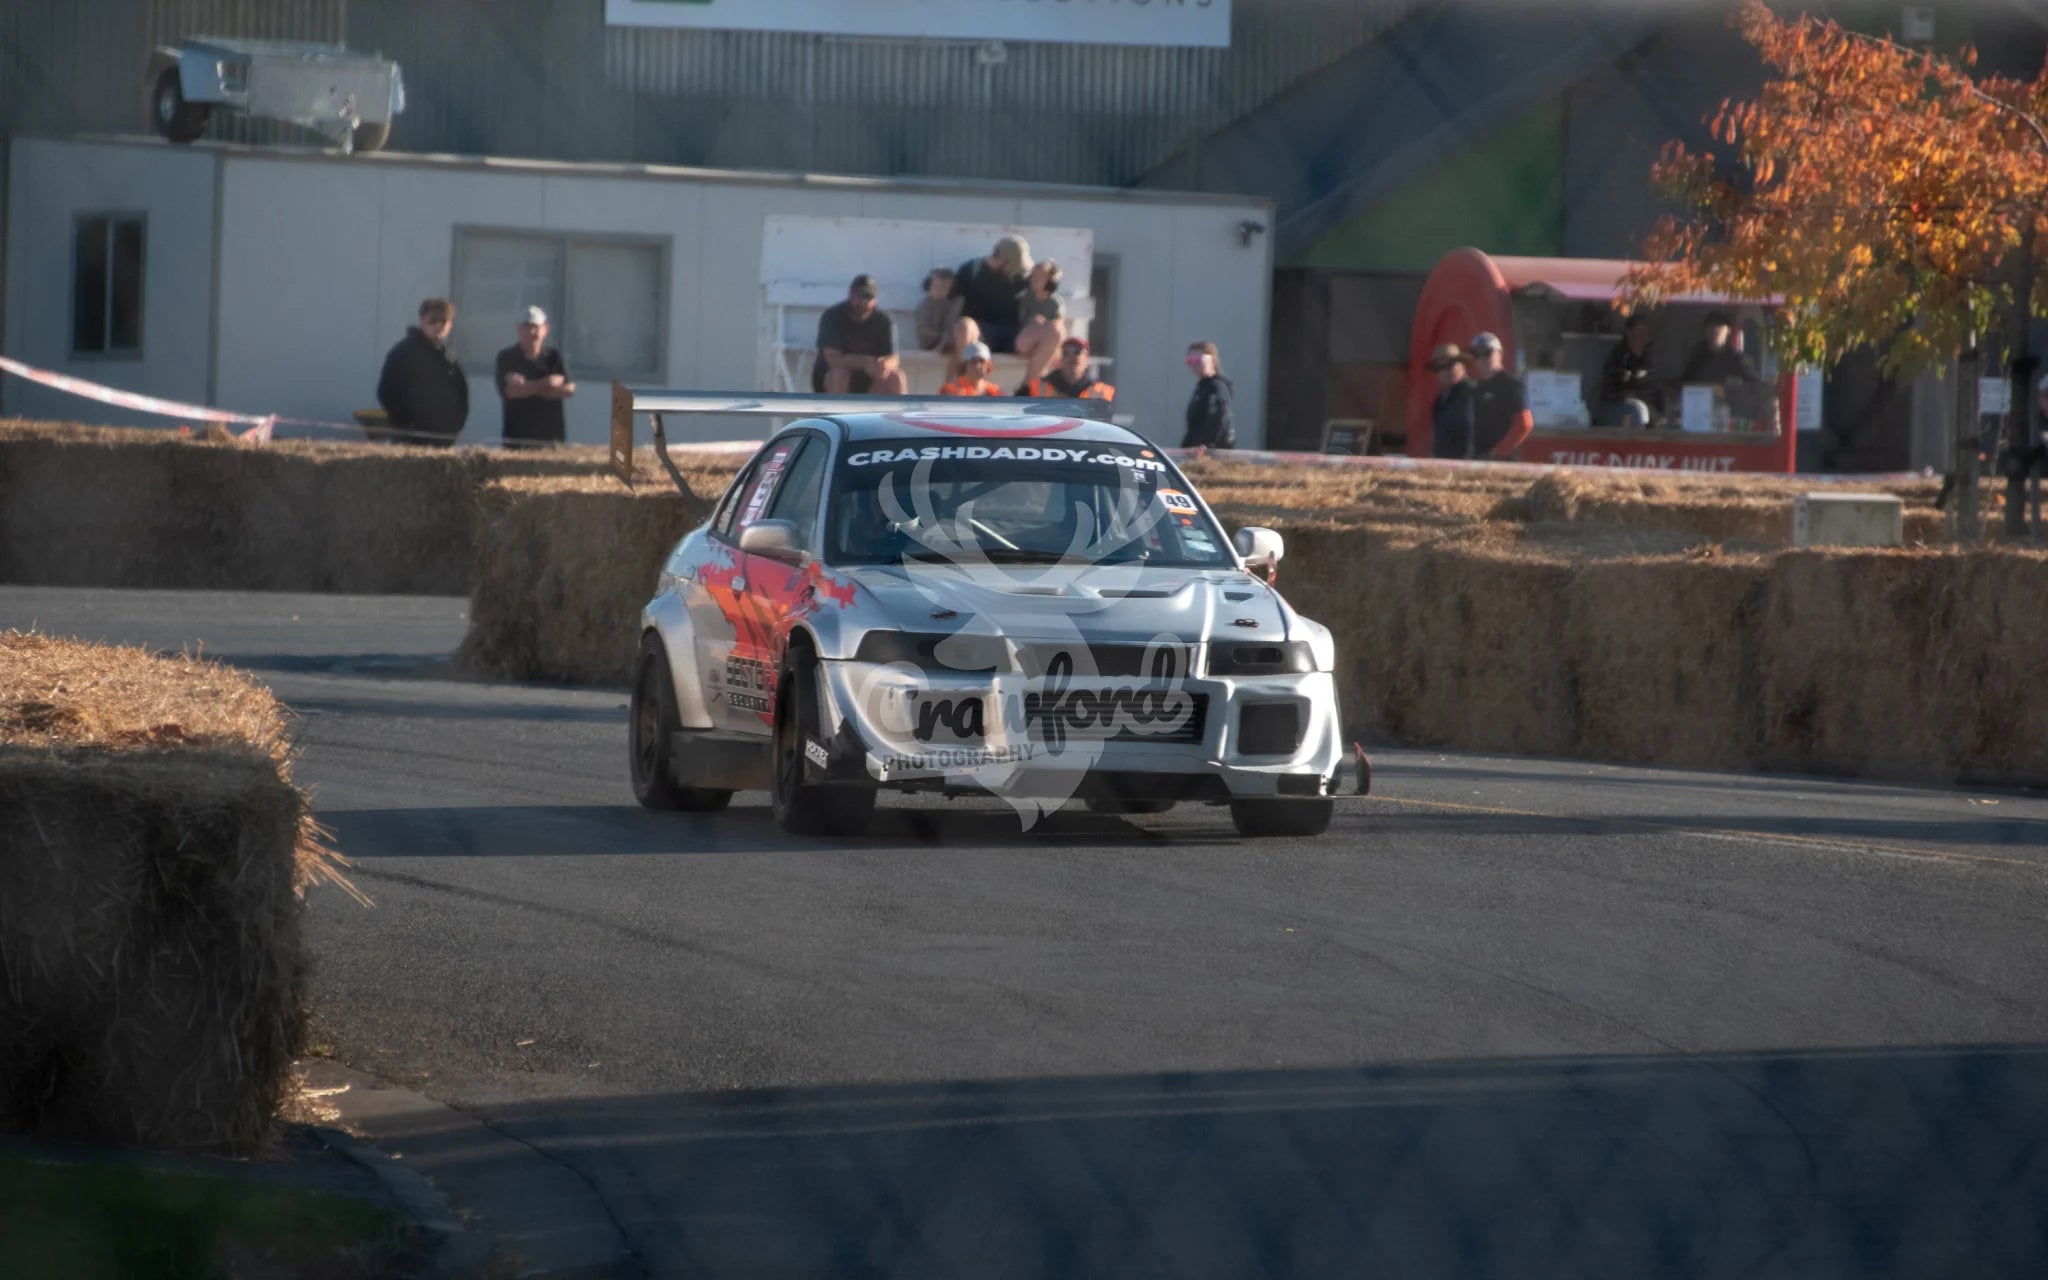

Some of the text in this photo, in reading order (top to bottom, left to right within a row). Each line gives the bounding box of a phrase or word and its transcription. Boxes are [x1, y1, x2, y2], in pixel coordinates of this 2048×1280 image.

[847, 446, 1166, 473] CRASHDADDY.com
[1165, 494, 1192, 509] 49
[727, 692, 770, 712] SECURITY
